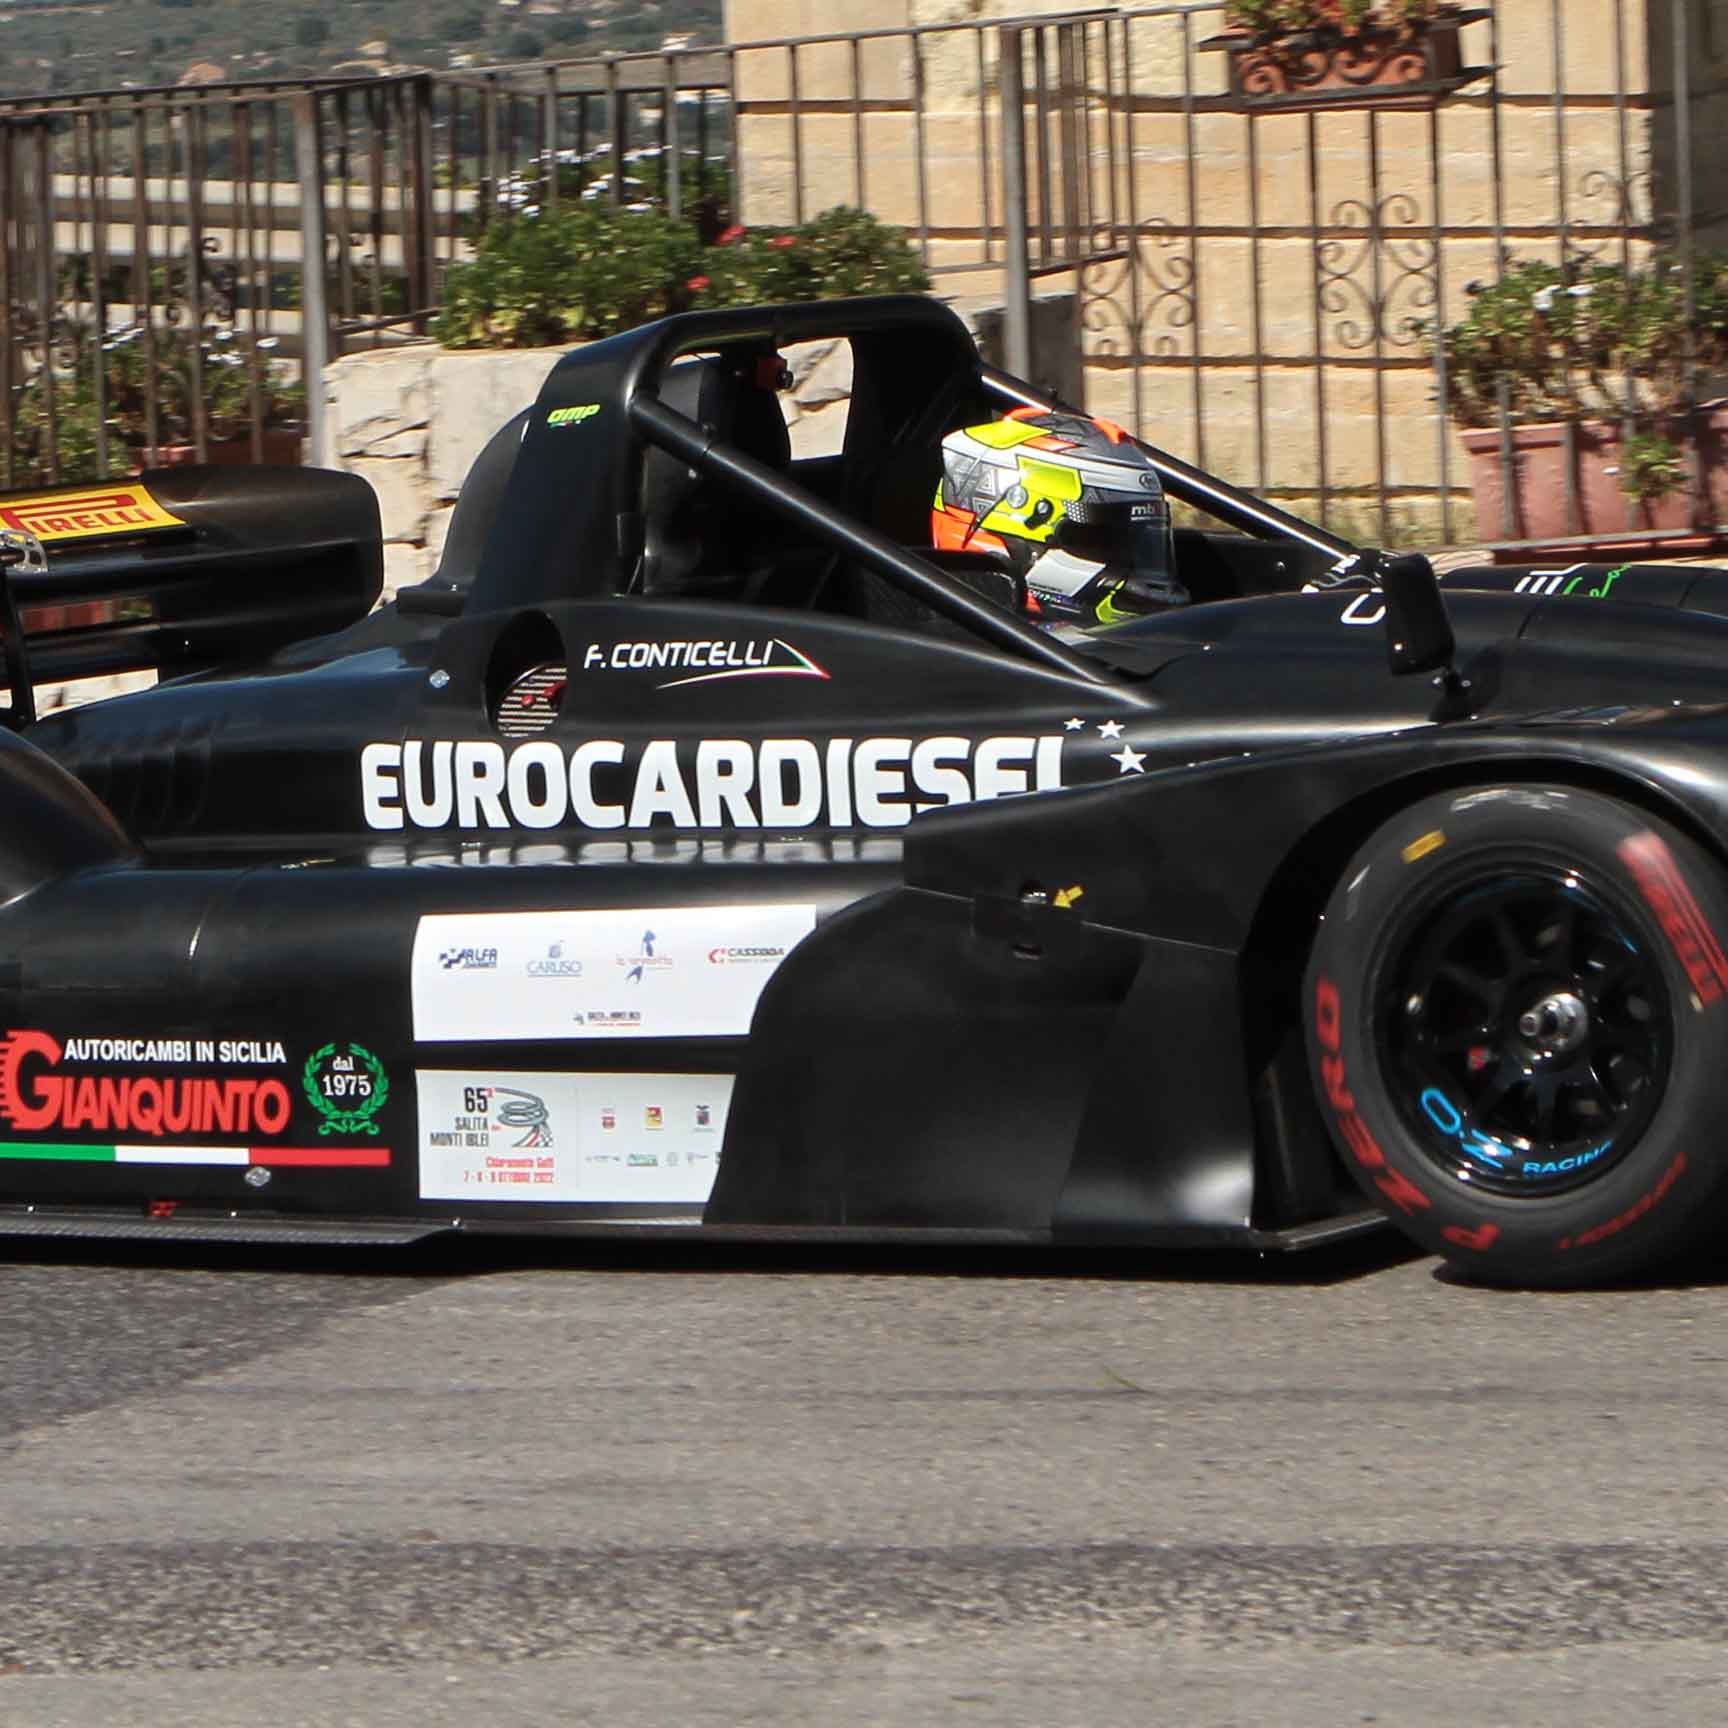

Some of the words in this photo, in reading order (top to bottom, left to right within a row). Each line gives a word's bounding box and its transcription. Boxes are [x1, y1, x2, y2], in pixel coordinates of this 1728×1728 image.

[527, 960, 584, 975] CARUSO
[64, 1039, 192, 1064] AUTORICAMBI
[196, 1040, 218, 1063] IN
[219, 1041, 287, 1064] SICILIA
[332, 1055, 355, 1072] dal
[323, 1074, 372, 1097] 1975
